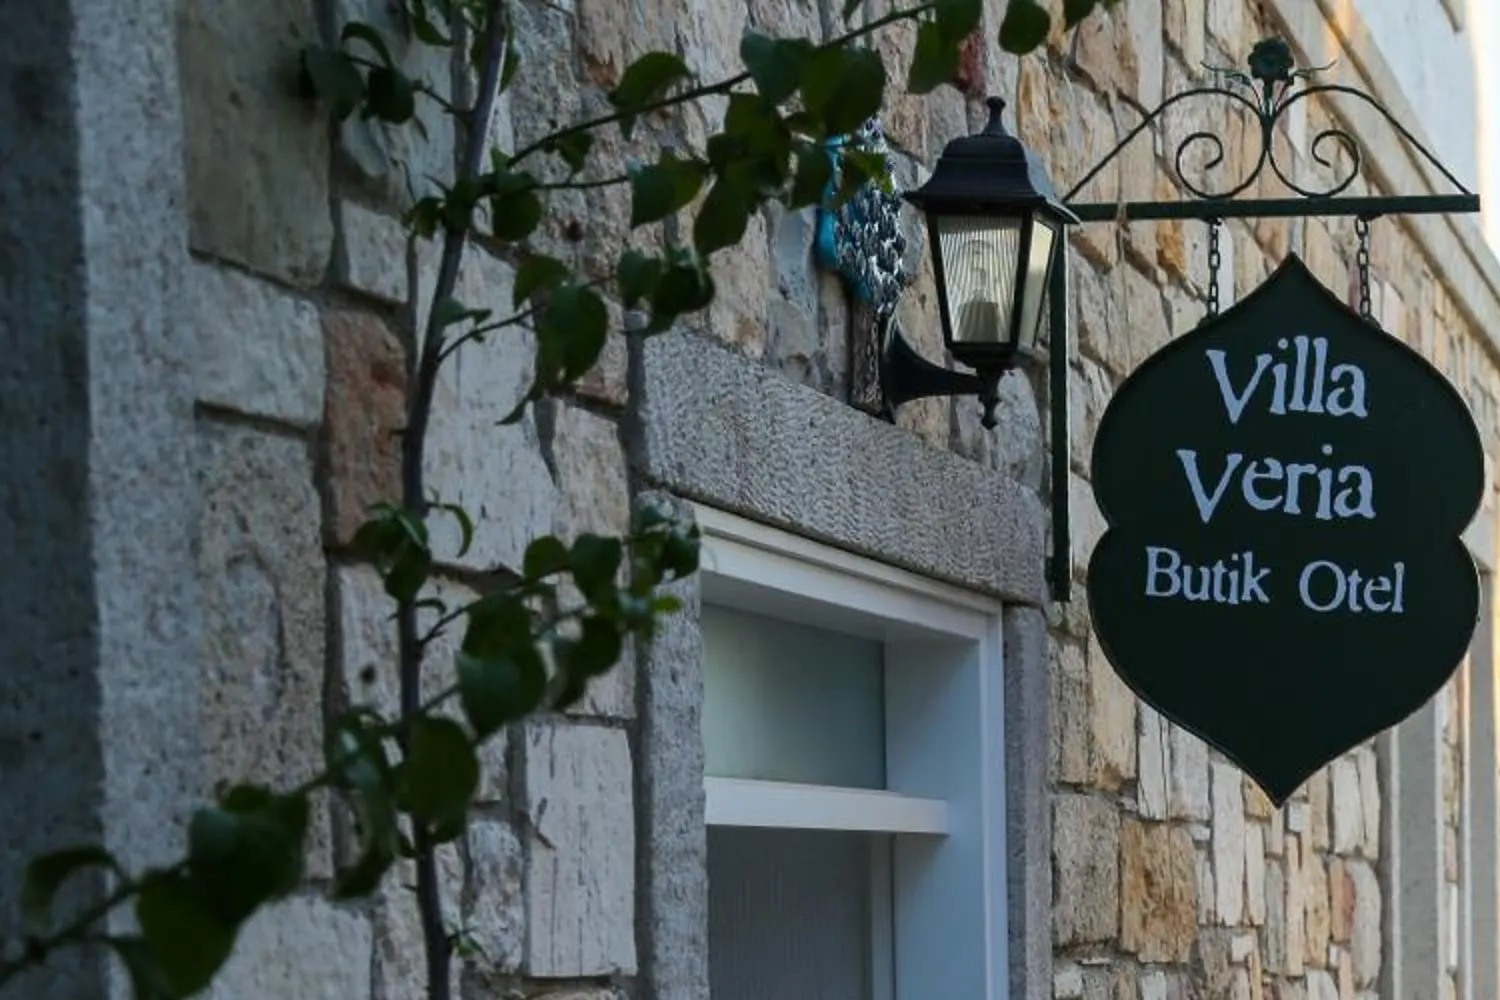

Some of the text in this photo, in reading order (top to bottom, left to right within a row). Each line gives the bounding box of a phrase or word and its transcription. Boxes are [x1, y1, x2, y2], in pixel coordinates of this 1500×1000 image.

[1205, 335, 1369, 424] Villa
[1176, 444, 1377, 523] Veria
[1145, 546, 1406, 613] Butik Otel
